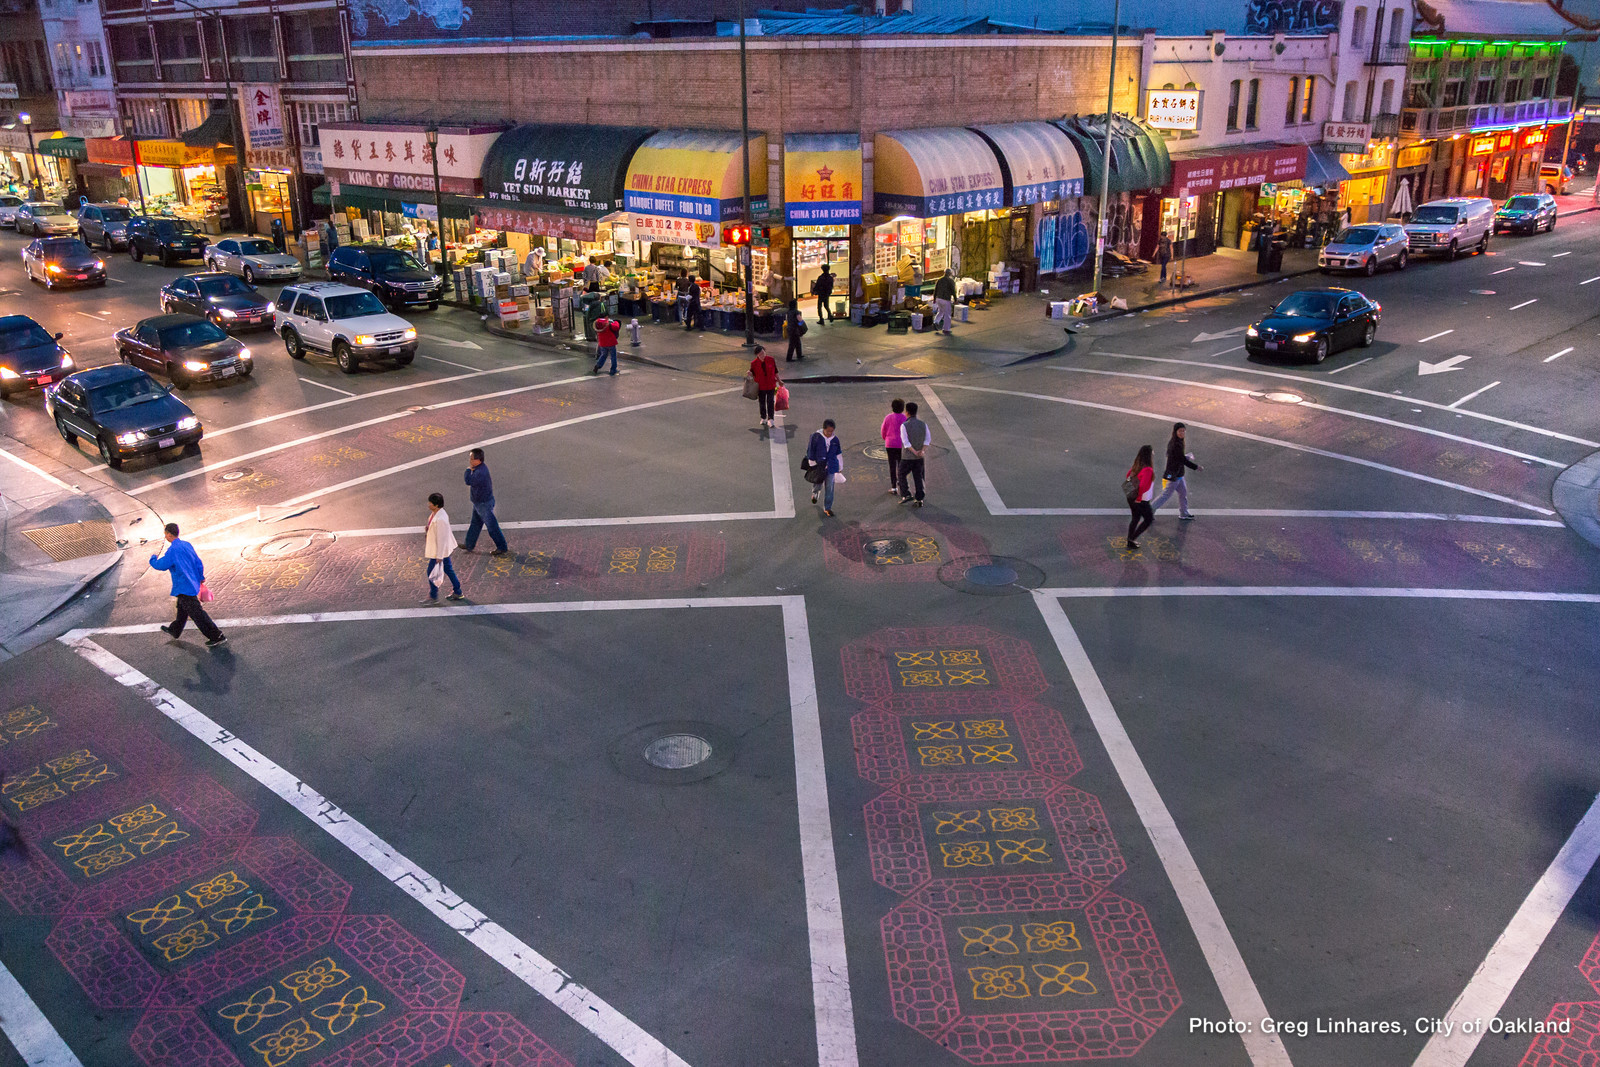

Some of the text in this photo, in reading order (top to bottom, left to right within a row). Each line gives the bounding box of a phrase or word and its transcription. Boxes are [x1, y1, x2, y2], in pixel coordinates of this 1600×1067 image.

[253, 89, 272, 126] 金牌
[348, 171, 372, 186] KING
[376, 173, 390, 187] OF
[632, 173, 713, 196] CHINA STAR EXPRESS
[928, 178, 948, 193] CHINA
[1219, 174, 1267, 189] RUBY KING BAKERY
[503, 182, 591, 200] YET SUN MARKET
[801, 182, 853, 200] 好旺角
[629, 196, 712, 216] BANQUET BUFFET FOOD TO GO
[790, 208, 860, 219] CHINA STAR EXPRESS
